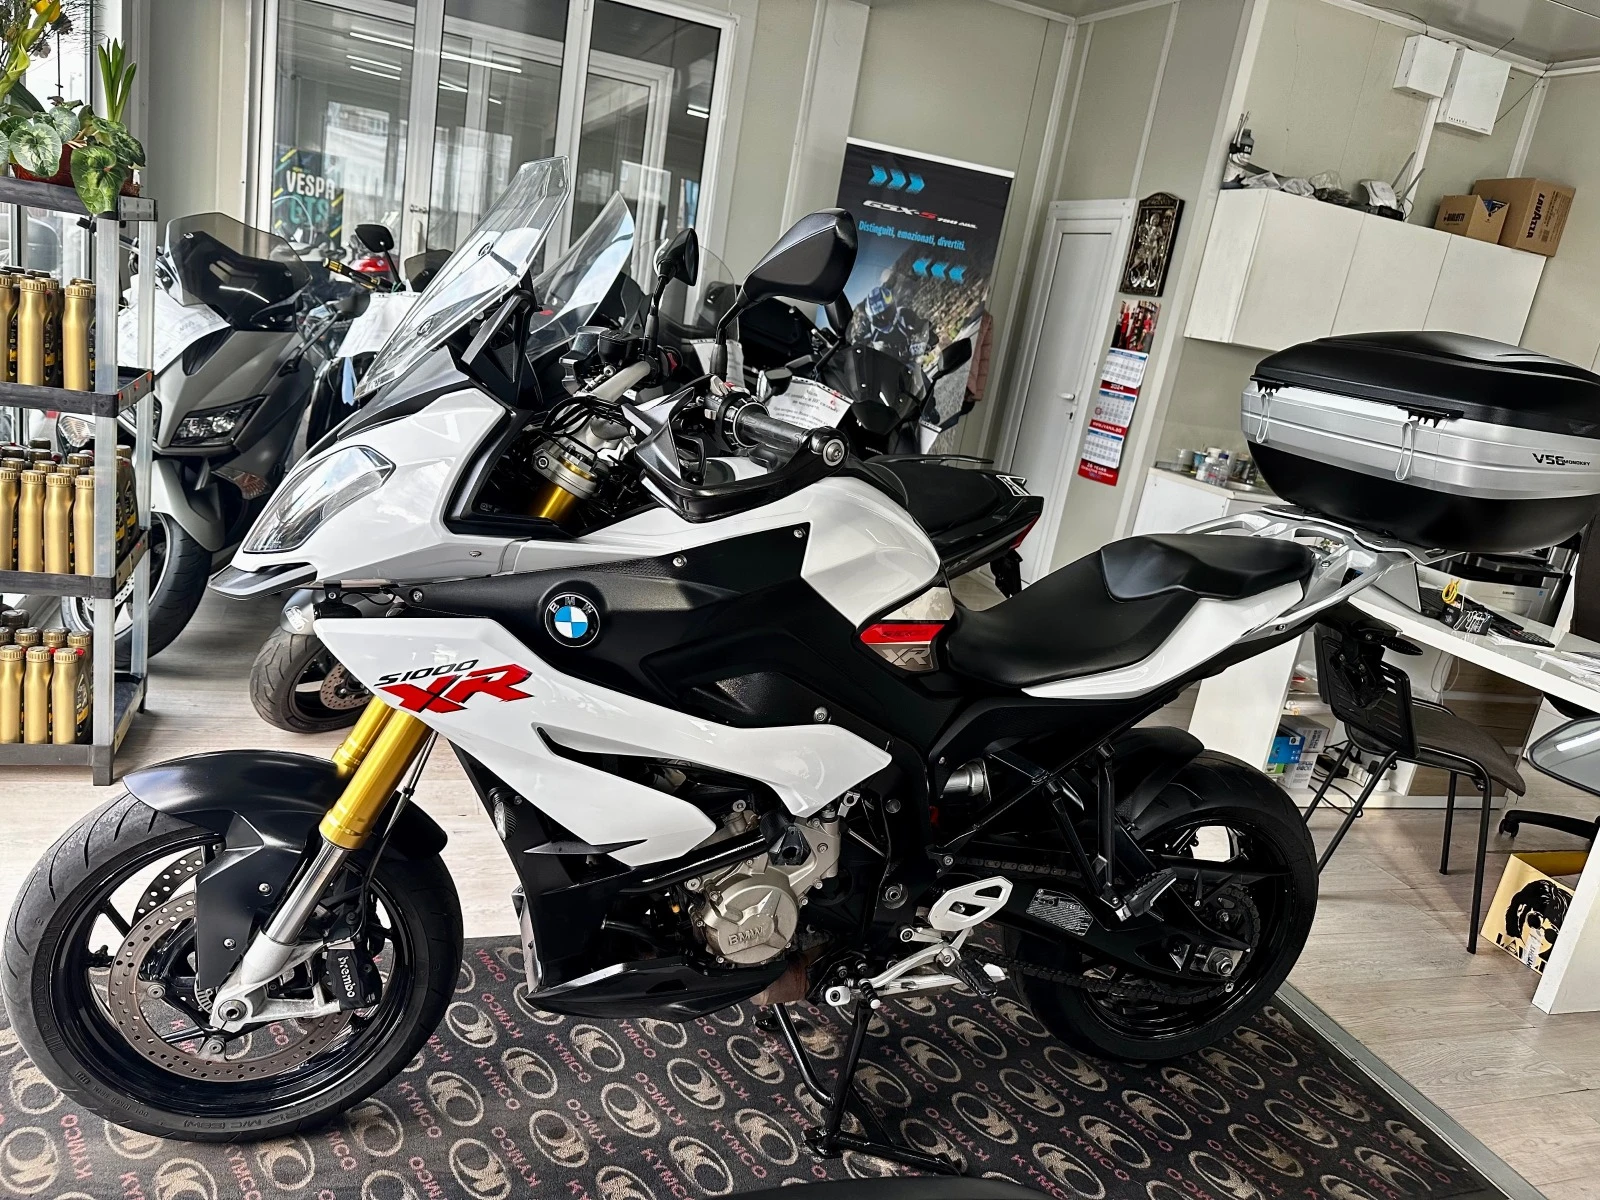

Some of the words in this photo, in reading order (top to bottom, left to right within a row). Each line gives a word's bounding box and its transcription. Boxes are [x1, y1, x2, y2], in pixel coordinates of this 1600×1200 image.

[286, 170, 335, 200] VESPA
[859, 220, 895, 239] Distinguiti,
[897, 230, 936, 247] emozionati,
[1532, 453, 1565, 465] V56
[374, 659, 479, 687] S1000
[882, 647, 931, 666] XR
[378, 663, 535, 714] XR
[727, 926, 763, 946] BMW
[338, 956, 357, 998] brembo
[474, 949, 507, 982] YMCO
[482, 993, 524, 1039] KYMCO
[617, 1019, 656, 1058] YMCO
[878, 1004, 910, 1029] KYM
[973, 1004, 1030, 1047] KYMCO
[428, 1035, 452, 1064] KYM
[545, 1033, 592, 1083] KYMCO
[880, 1045, 937, 1093] KYMCO
[928, 1023, 986, 1068] KYMCO
[474, 1056, 521, 1110] KYMCO
[697, 1049, 750, 1101] KYMCO
[1020, 1059, 1085, 1106] KYMCO
[1312, 1067, 1384, 1113] KYMCO
[398, 1081, 442, 1138] KYMCO
[635, 1072, 687, 1127] KYMCO
[770, 1093, 812, 1130] KYM
[975, 1081, 1039, 1133] KYMCO
[1144, 1077, 1213, 1124] KYMCO
[1279, 1089, 1353, 1138] KYMCO
[61, 1114, 93, 1180] KYMCO
[566, 1098, 617, 1155] KYMCO
[709, 1119, 767, 1178] KYMCO
[925, 1107, 991, 1161] KYMCO
[1103, 1100, 1173, 1151] KYMCO
[1245, 1113, 1321, 1165] KYMCO
[326, 1130, 357, 1170] MCO
[491, 1126, 541, 1188] KYMCO
[1059, 1126, 1130, 1181] KYMCO
[1207, 1139, 1284, 1196] KYMCO
[1370, 1131, 1452, 1184] KYMCO
[229, 1148, 262, 1200] YMCO
[409, 1156, 446, 1200] MCO
[640, 1148, 696, 1200] KYMC
[1011, 1153, 1069, 1200] KYMC
[1167, 1168, 1214, 1200] MCO
[1339, 1158, 1401, 1200] KYMC
